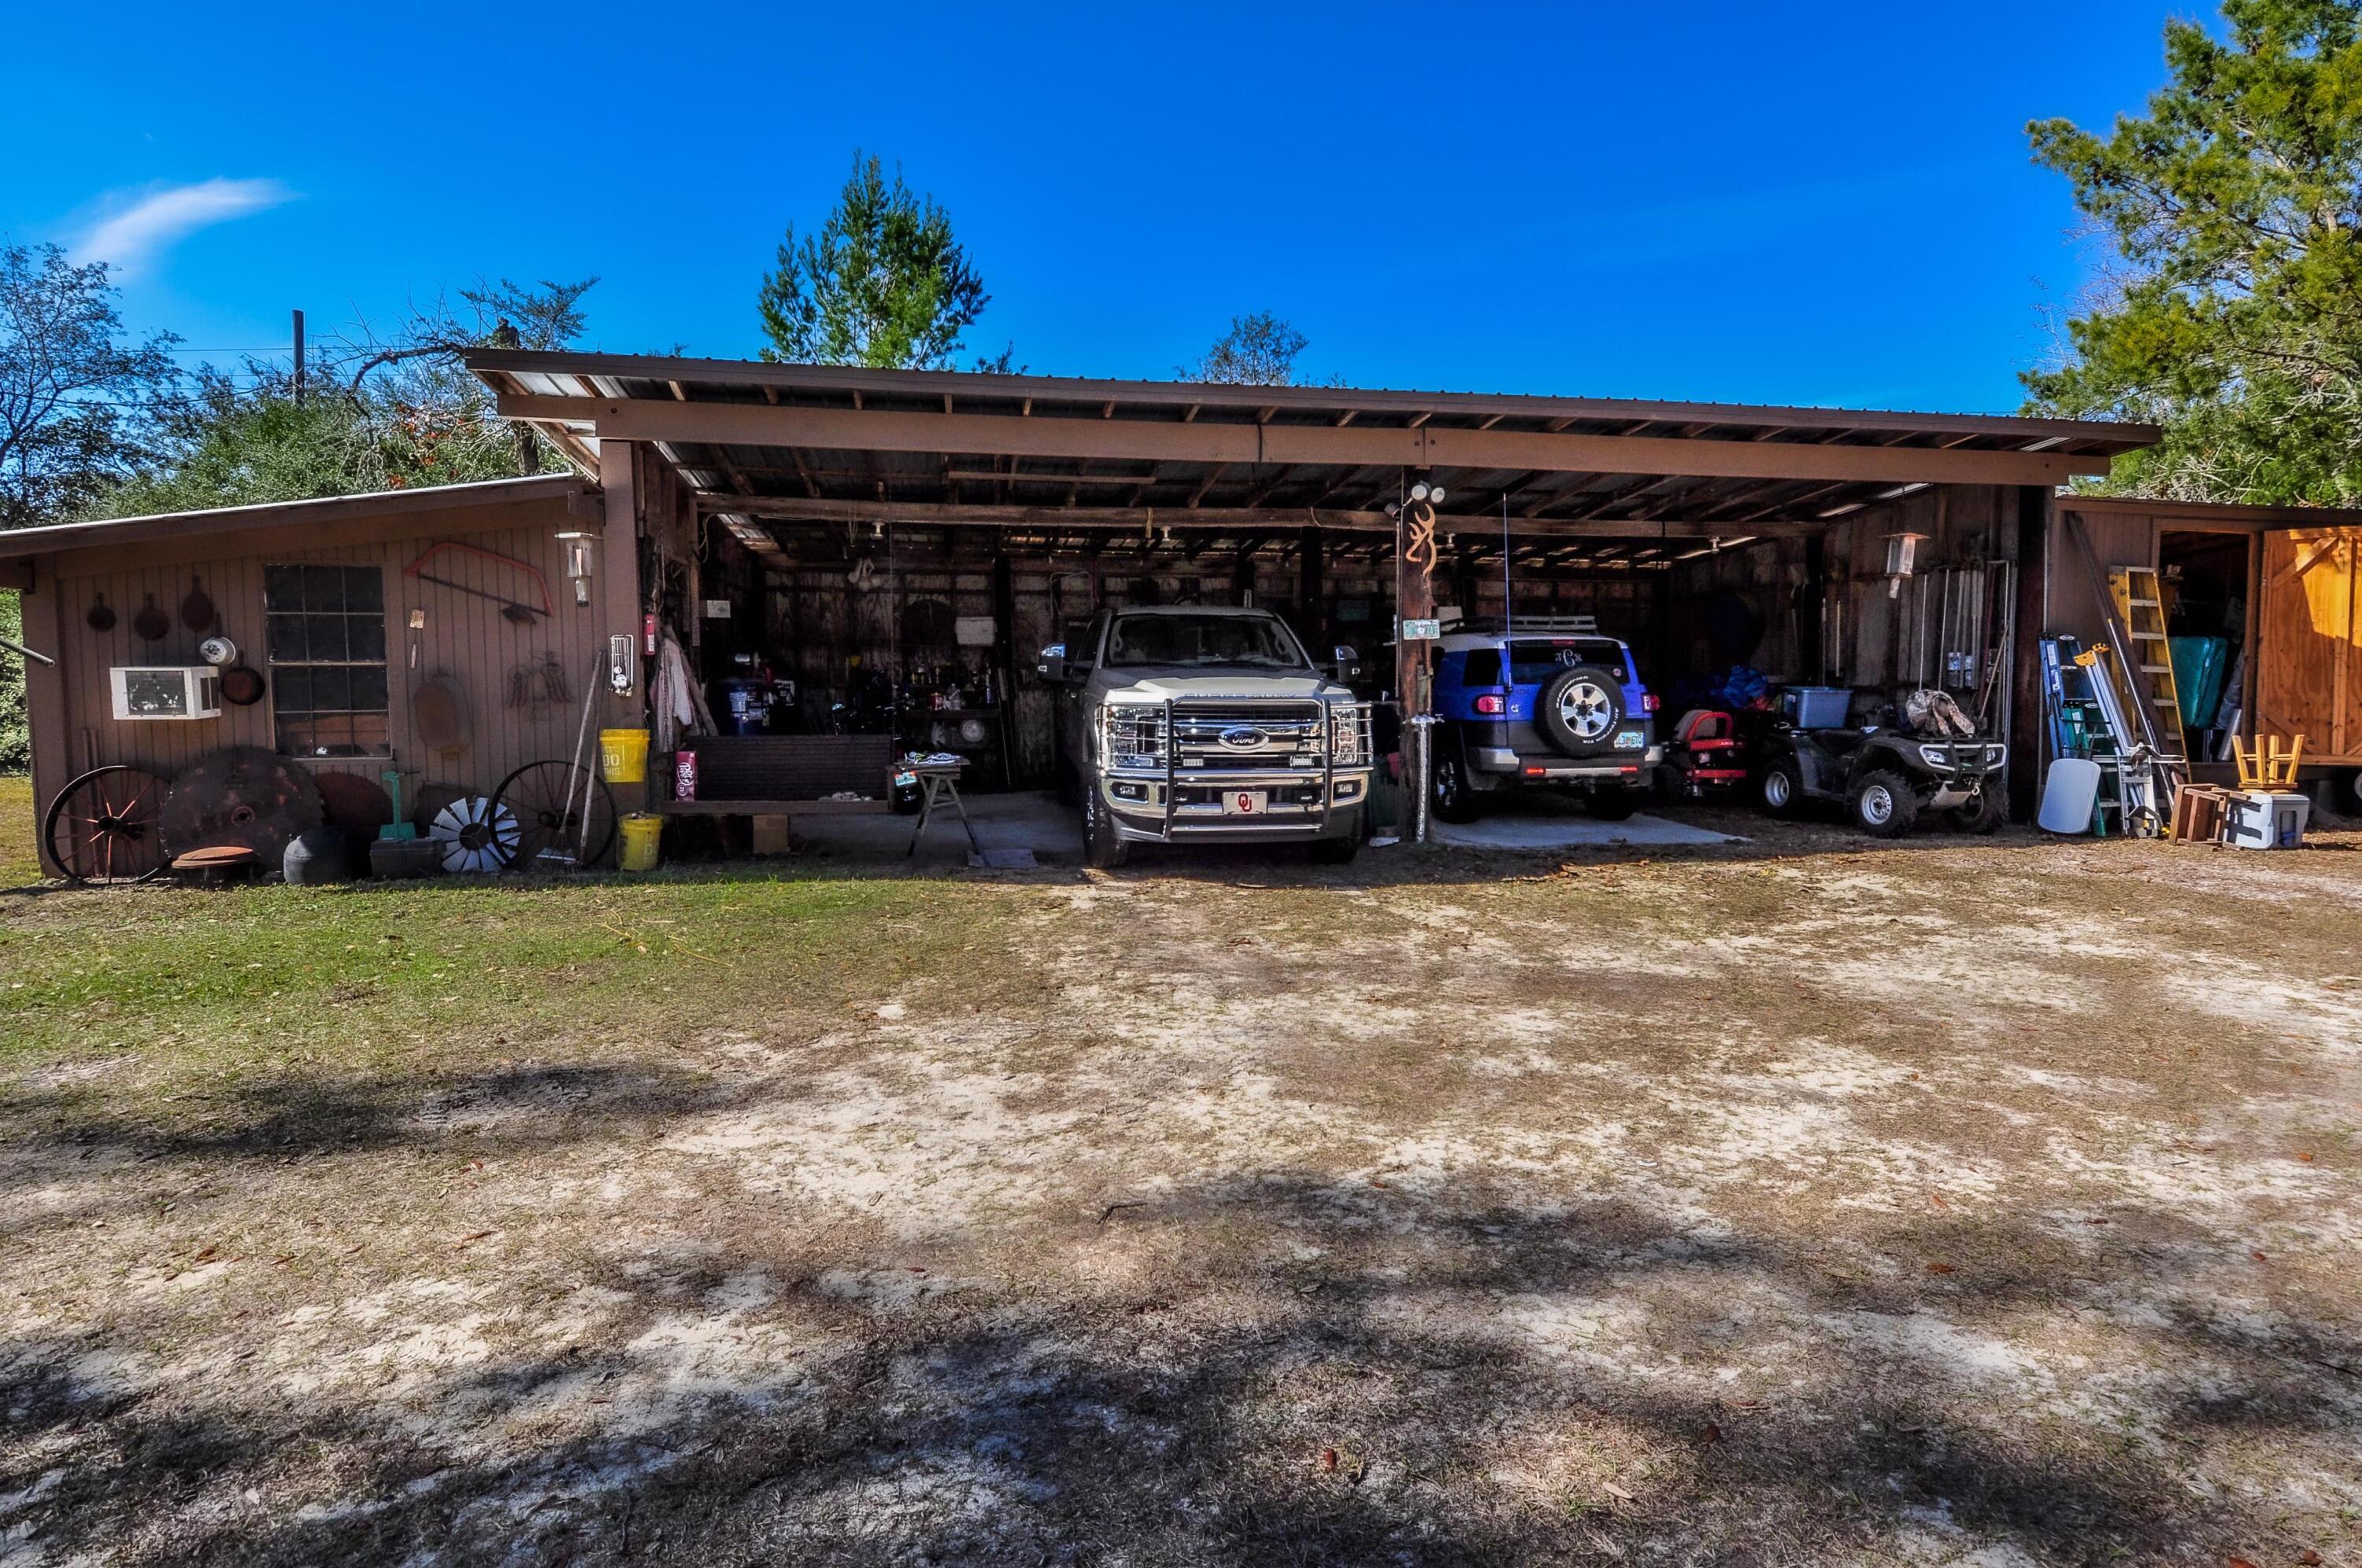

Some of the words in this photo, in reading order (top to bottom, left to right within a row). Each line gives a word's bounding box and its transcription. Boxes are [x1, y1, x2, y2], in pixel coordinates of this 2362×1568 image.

[1232, 734, 1256, 744] Ford
[603, 753, 620, 767] DO
[1238, 793, 1252, 812] OU
